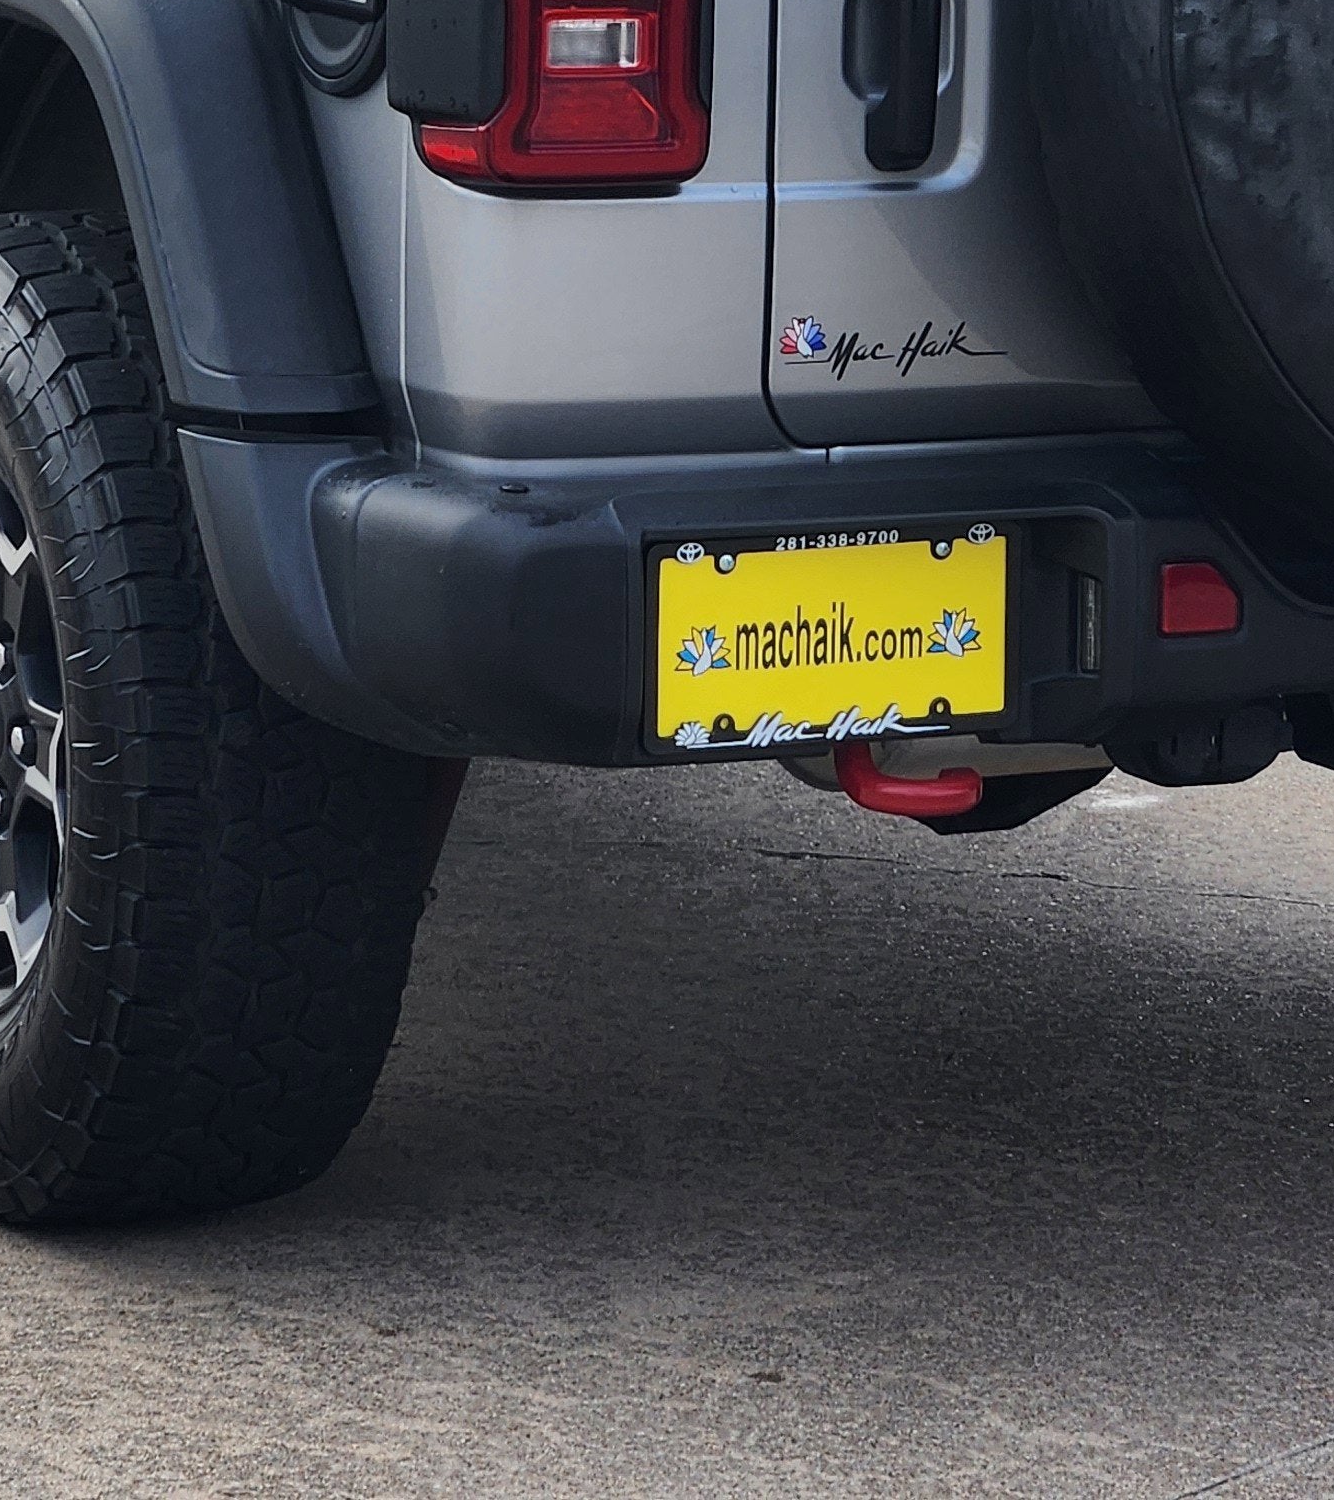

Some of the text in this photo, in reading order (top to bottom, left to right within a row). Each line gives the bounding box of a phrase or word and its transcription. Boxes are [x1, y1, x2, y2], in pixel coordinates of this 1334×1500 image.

[827, 320, 1007, 380] Mac Haik
[776, 529, 899, 551] 281-338-9700
[735, 601, 924, 671] machaik.com
[743, 702, 951, 750] Mac Haik
